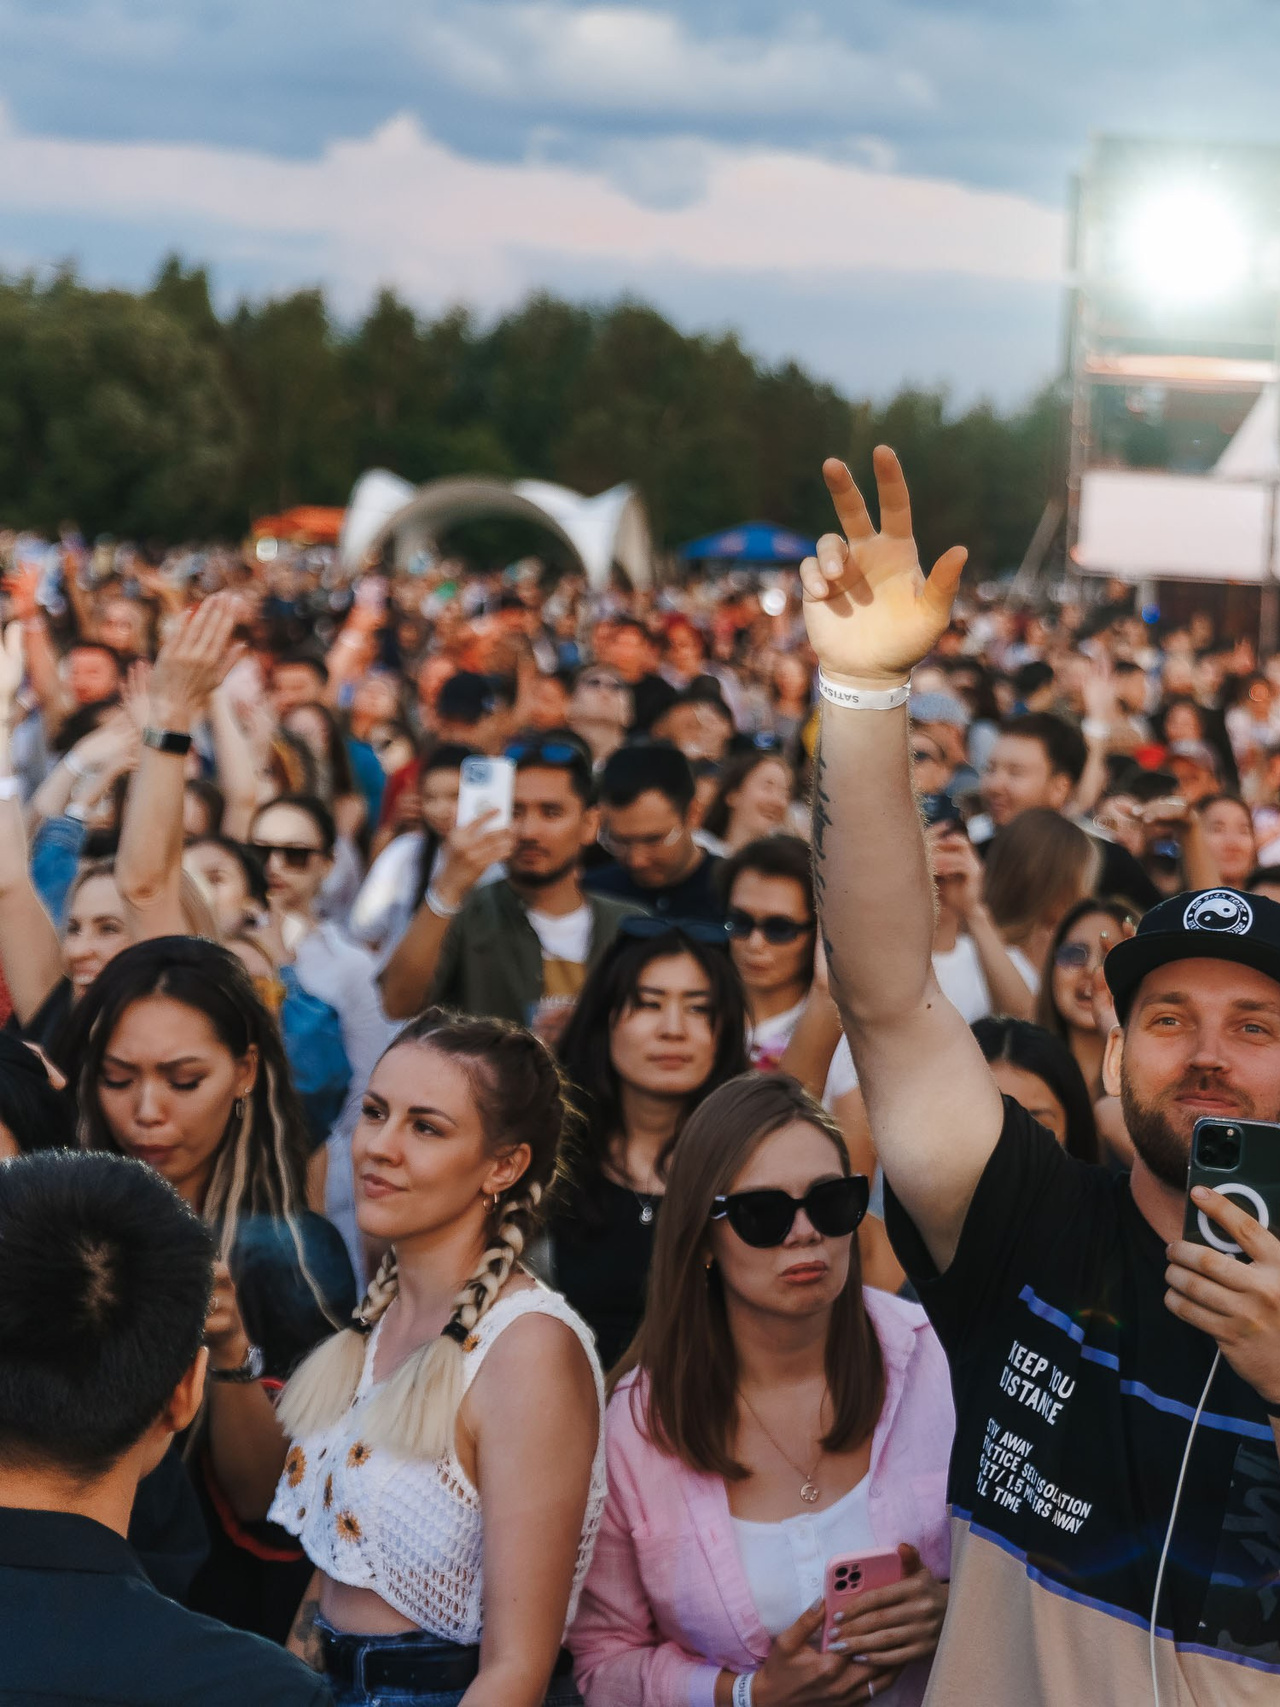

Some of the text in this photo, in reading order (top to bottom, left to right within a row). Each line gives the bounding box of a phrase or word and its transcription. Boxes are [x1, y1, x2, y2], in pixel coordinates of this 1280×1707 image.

[1008, 1340, 1049, 1378] KEEP
[999, 1366, 1064, 1426] DISTANCE
[982, 1434, 1022, 1473] PCTICE
[998, 1431, 1034, 1459] AWAY
[993, 1486, 1022, 1514] TIME
[1006, 1474, 1025, 1494] 1.5
[1051, 1509, 1084, 1534] AWAY
